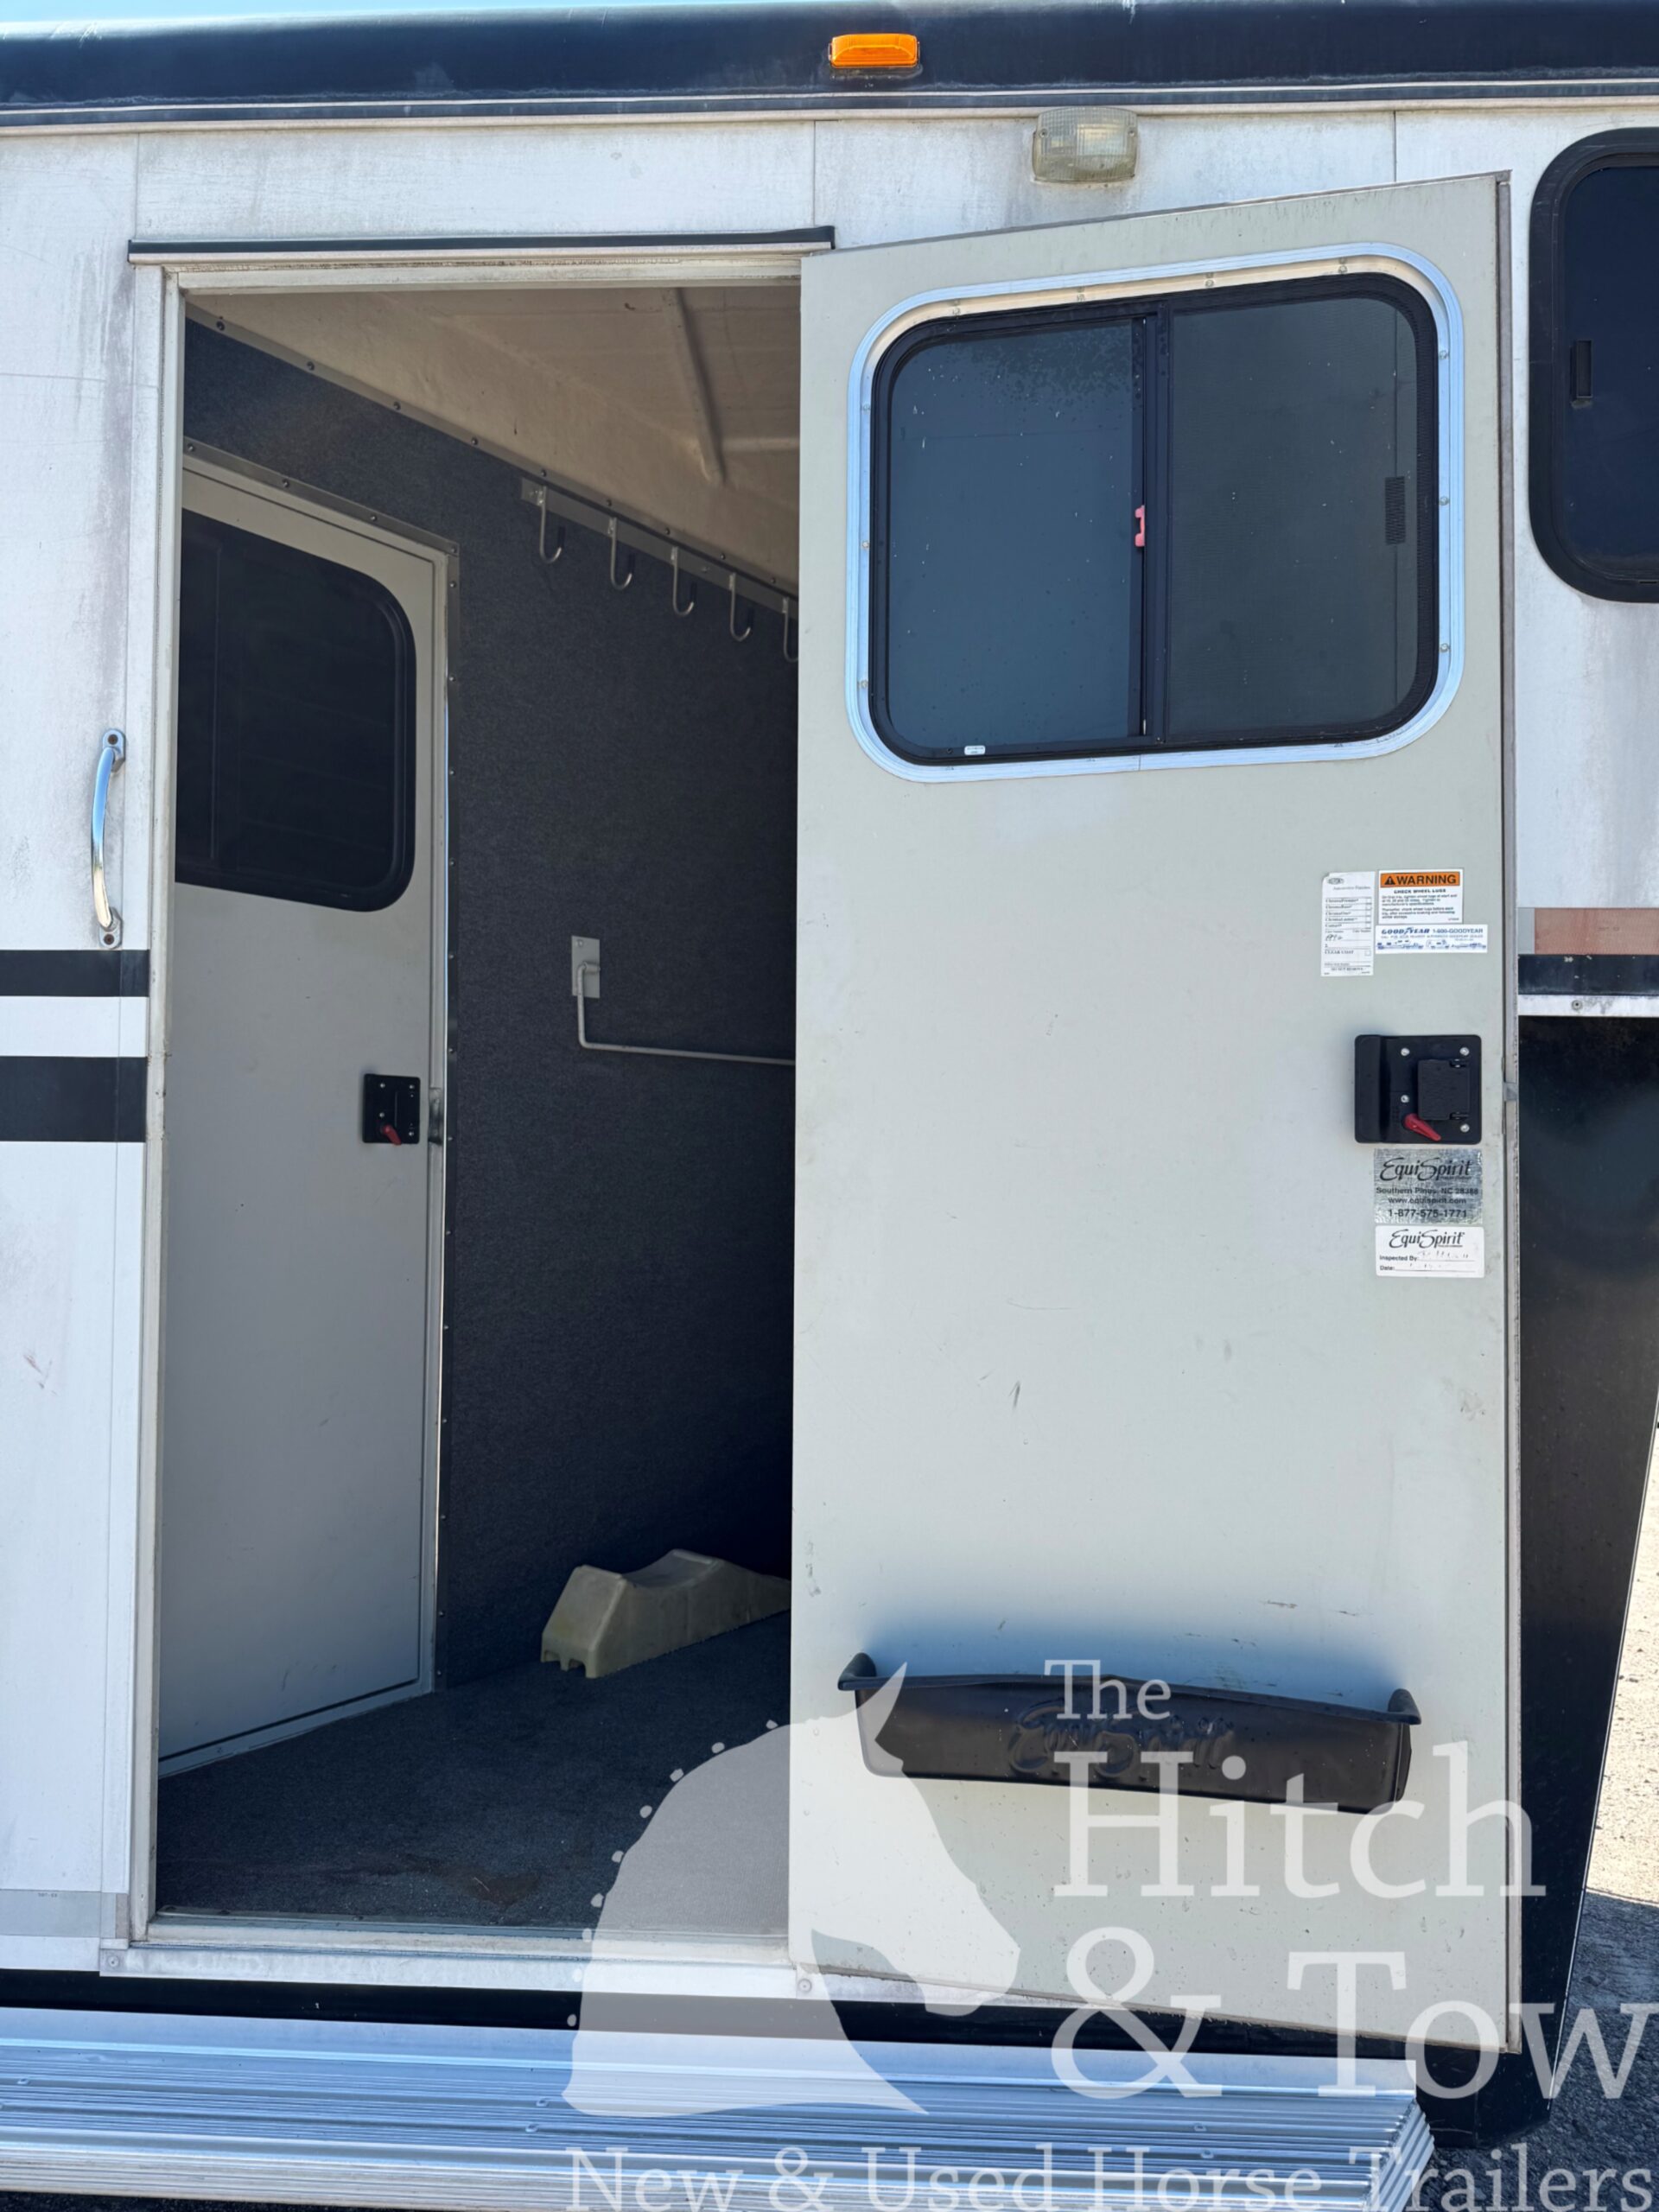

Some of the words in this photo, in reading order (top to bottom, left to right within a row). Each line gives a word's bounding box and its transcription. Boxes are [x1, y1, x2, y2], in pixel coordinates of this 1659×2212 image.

[1396, 874, 1457, 885] WARNING
[1379, 1157, 1472, 1181] EquiSpirit
[1389, 1209, 1467, 1217] 1-877-575-1771
[1389, 1229, 1465, 1249] EquiSpirit
